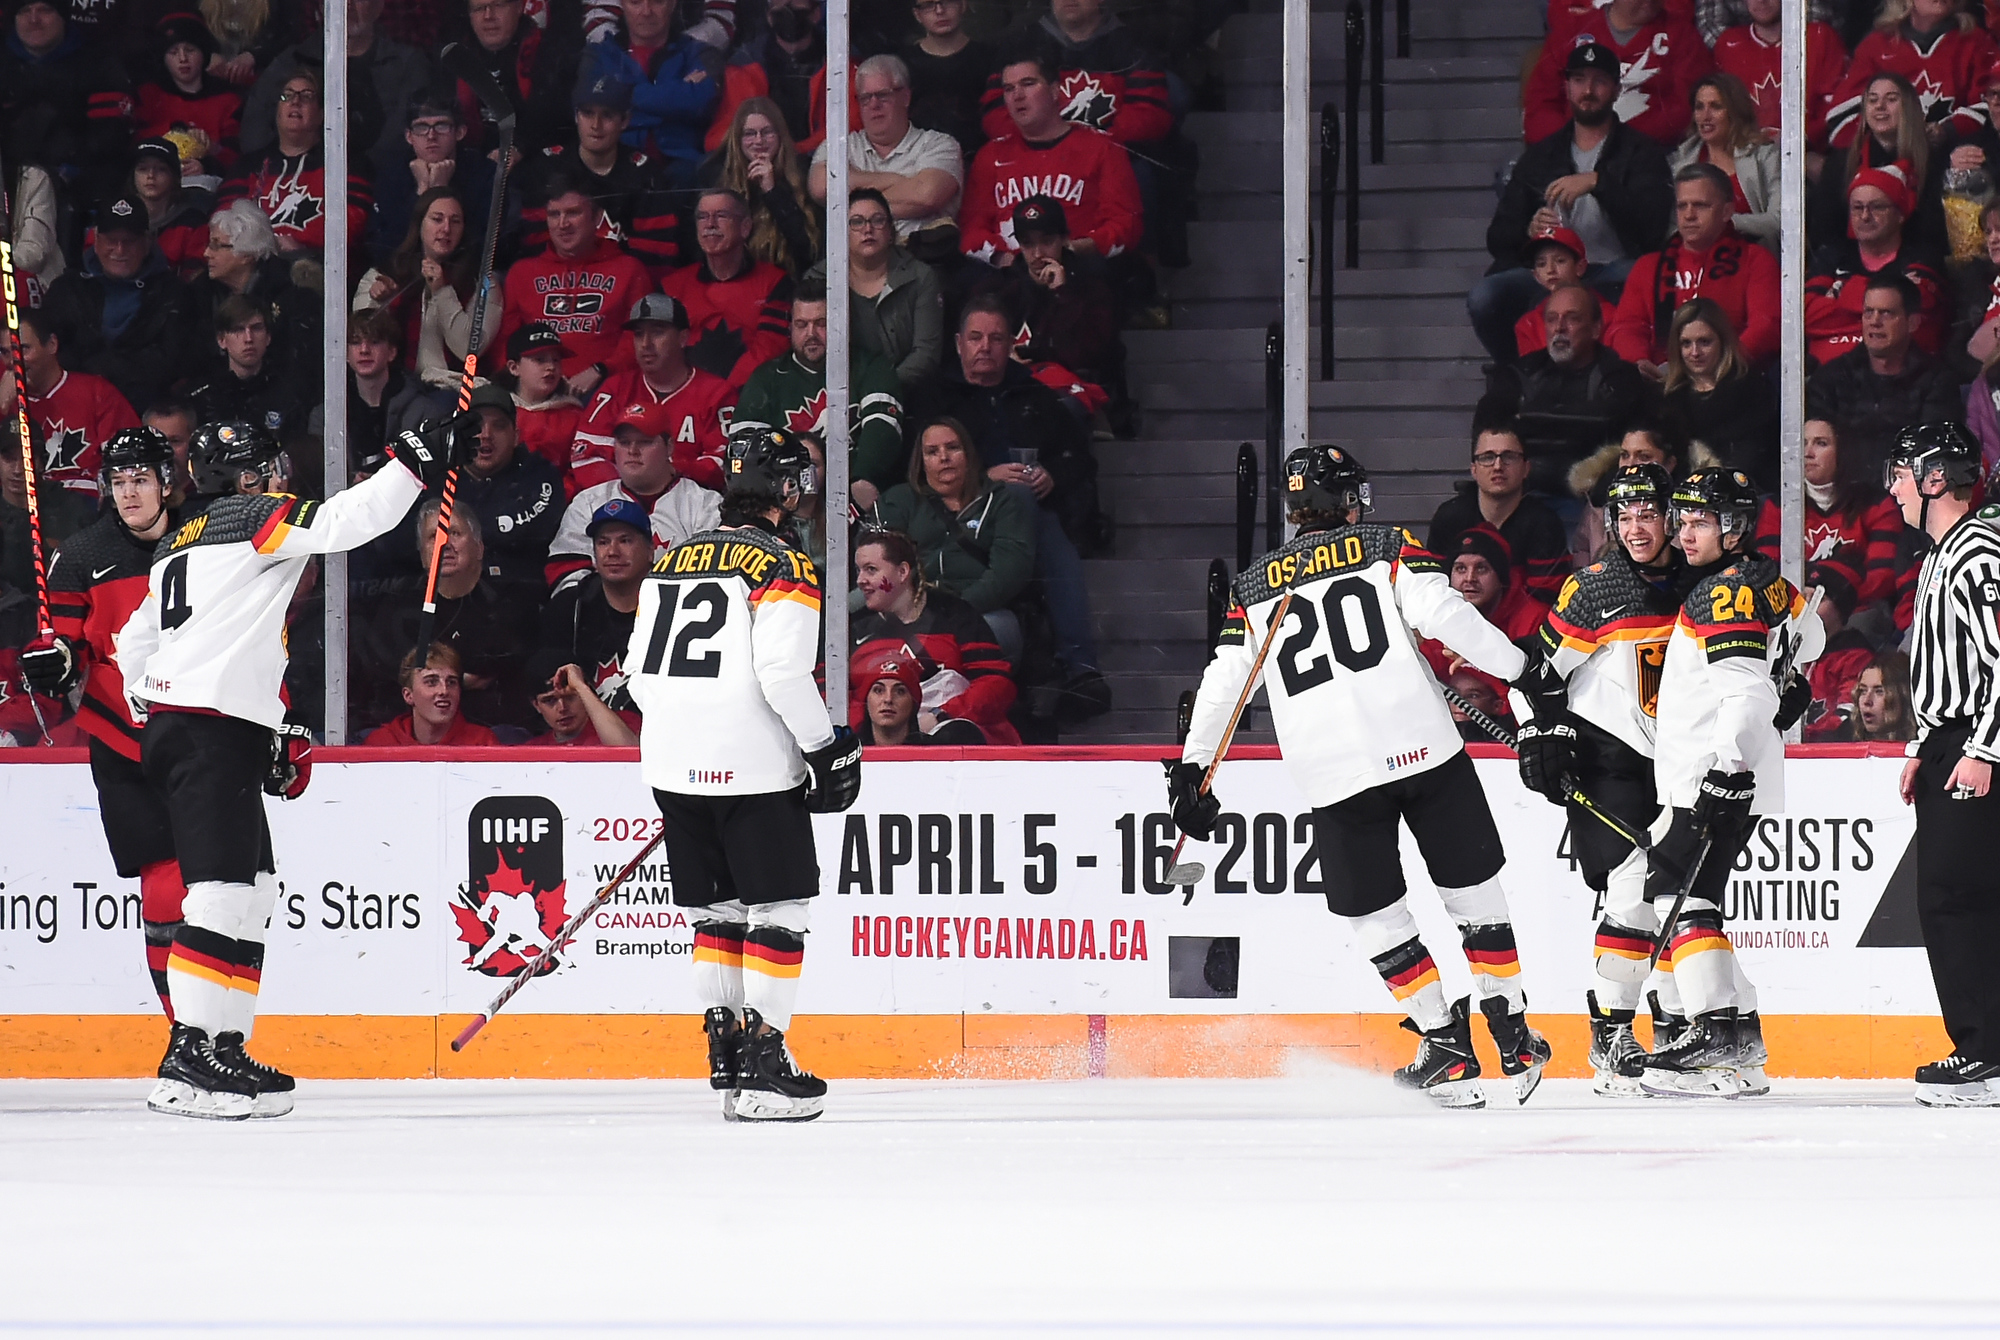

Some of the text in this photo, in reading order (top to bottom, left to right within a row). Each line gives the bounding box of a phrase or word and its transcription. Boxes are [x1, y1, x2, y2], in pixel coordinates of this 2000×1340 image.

[994, 173, 1085, 209] CANADA
[0, 241, 19, 330] CCM
[533, 271, 617, 295] CANADA
[588, 393, 612, 423] 7
[677, 415, 695, 444] A
[20, 423, 39, 518] JETSPEED
[731, 459, 743, 474] 12
[1288, 474, 1304, 492] 20
[674, 543, 716, 574] DER
[718, 542, 778, 583] LINDE
[784, 549, 818, 586] 12
[160, 552, 194, 632] 4
[1710, 584, 1755, 622] 24
[641, 582, 730, 679] 12
[1266, 575, 1390, 698] 20
[1395, 746, 1430, 769] IIHF
[698, 769, 734, 785] IIHF
[481, 817, 550, 844] IIHF
[837, 813, 1004, 895] APRIL
[1023, 813, 1058, 895] 5
[0, 882, 58, 944] ing
[321, 881, 421, 931] Stars
[595, 912, 687, 929] CANADA
[595, 939, 694, 959] Brampton
[851, 915, 1149, 961] HOCKEYCANADA.CA
